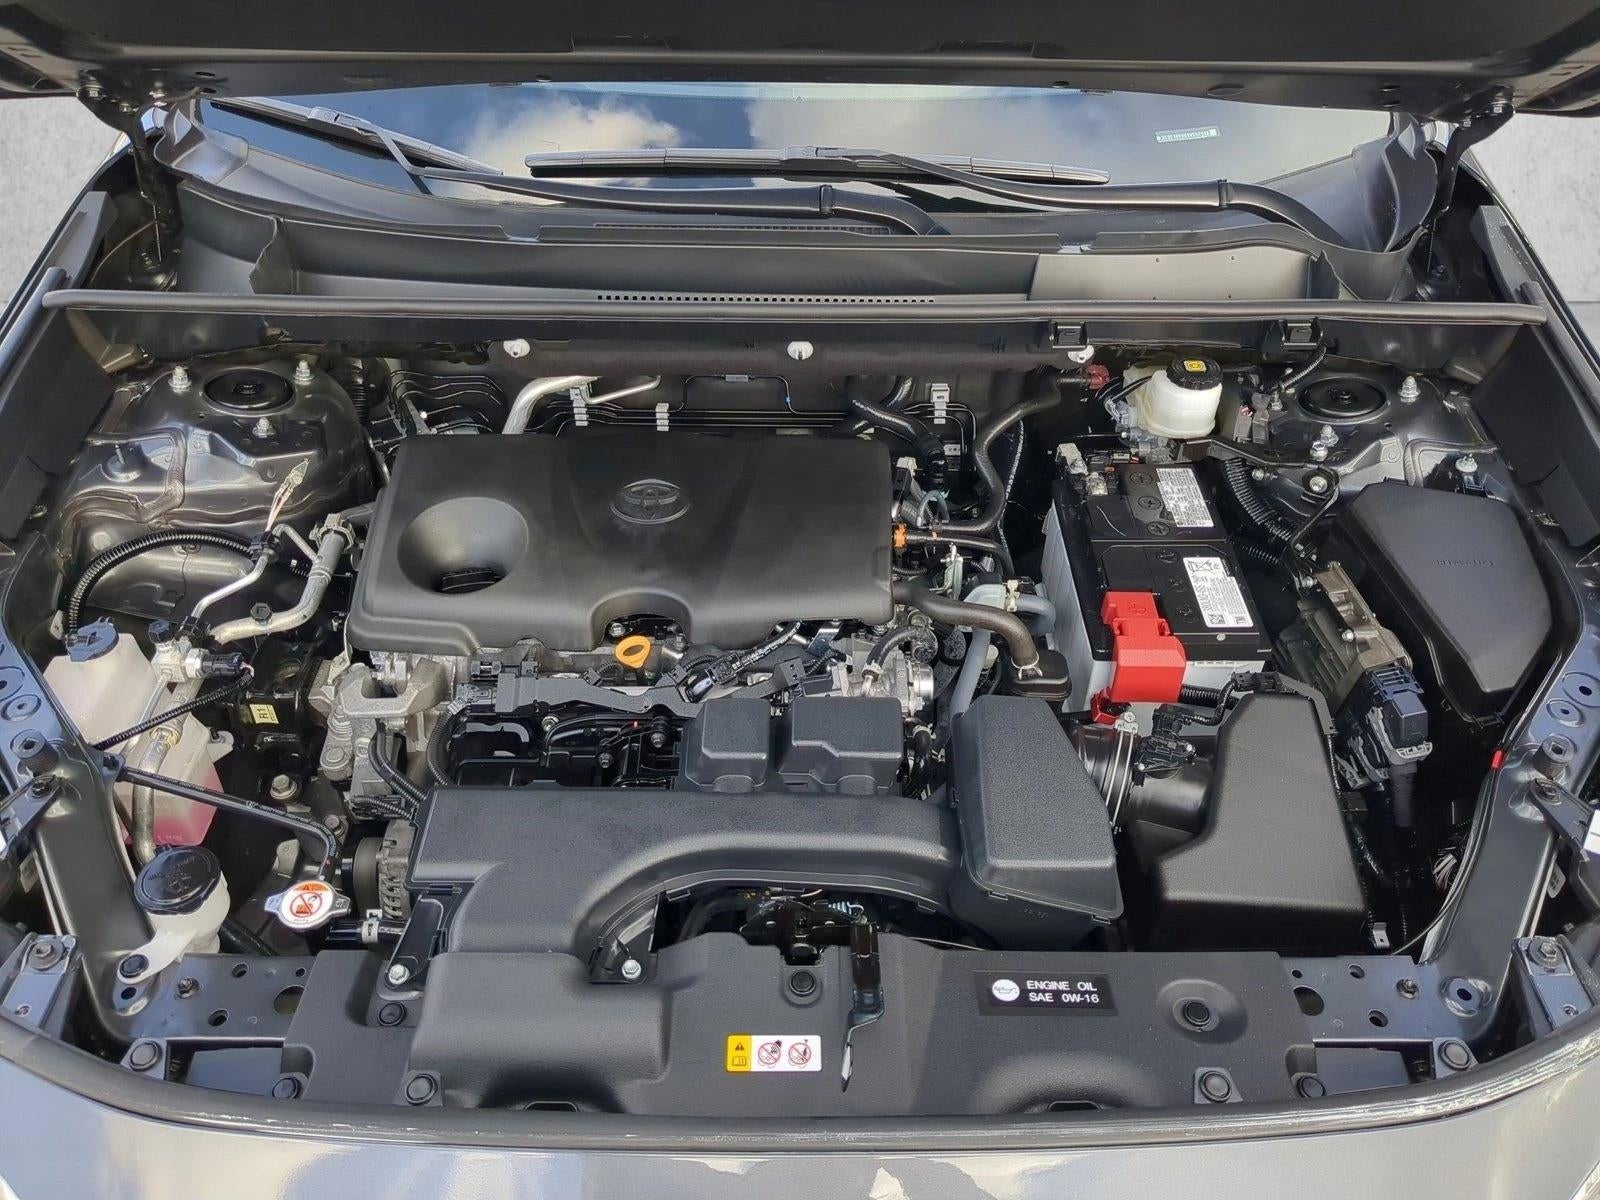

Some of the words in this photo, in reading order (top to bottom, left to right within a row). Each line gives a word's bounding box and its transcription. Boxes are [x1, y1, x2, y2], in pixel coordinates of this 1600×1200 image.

[1026, 980, 1070, 991] ENGINE
[1077, 982, 1097, 991] OIL
[1028, 992, 1054, 1002] SAE
[1061, 993, 1099, 1003] 0W-16
